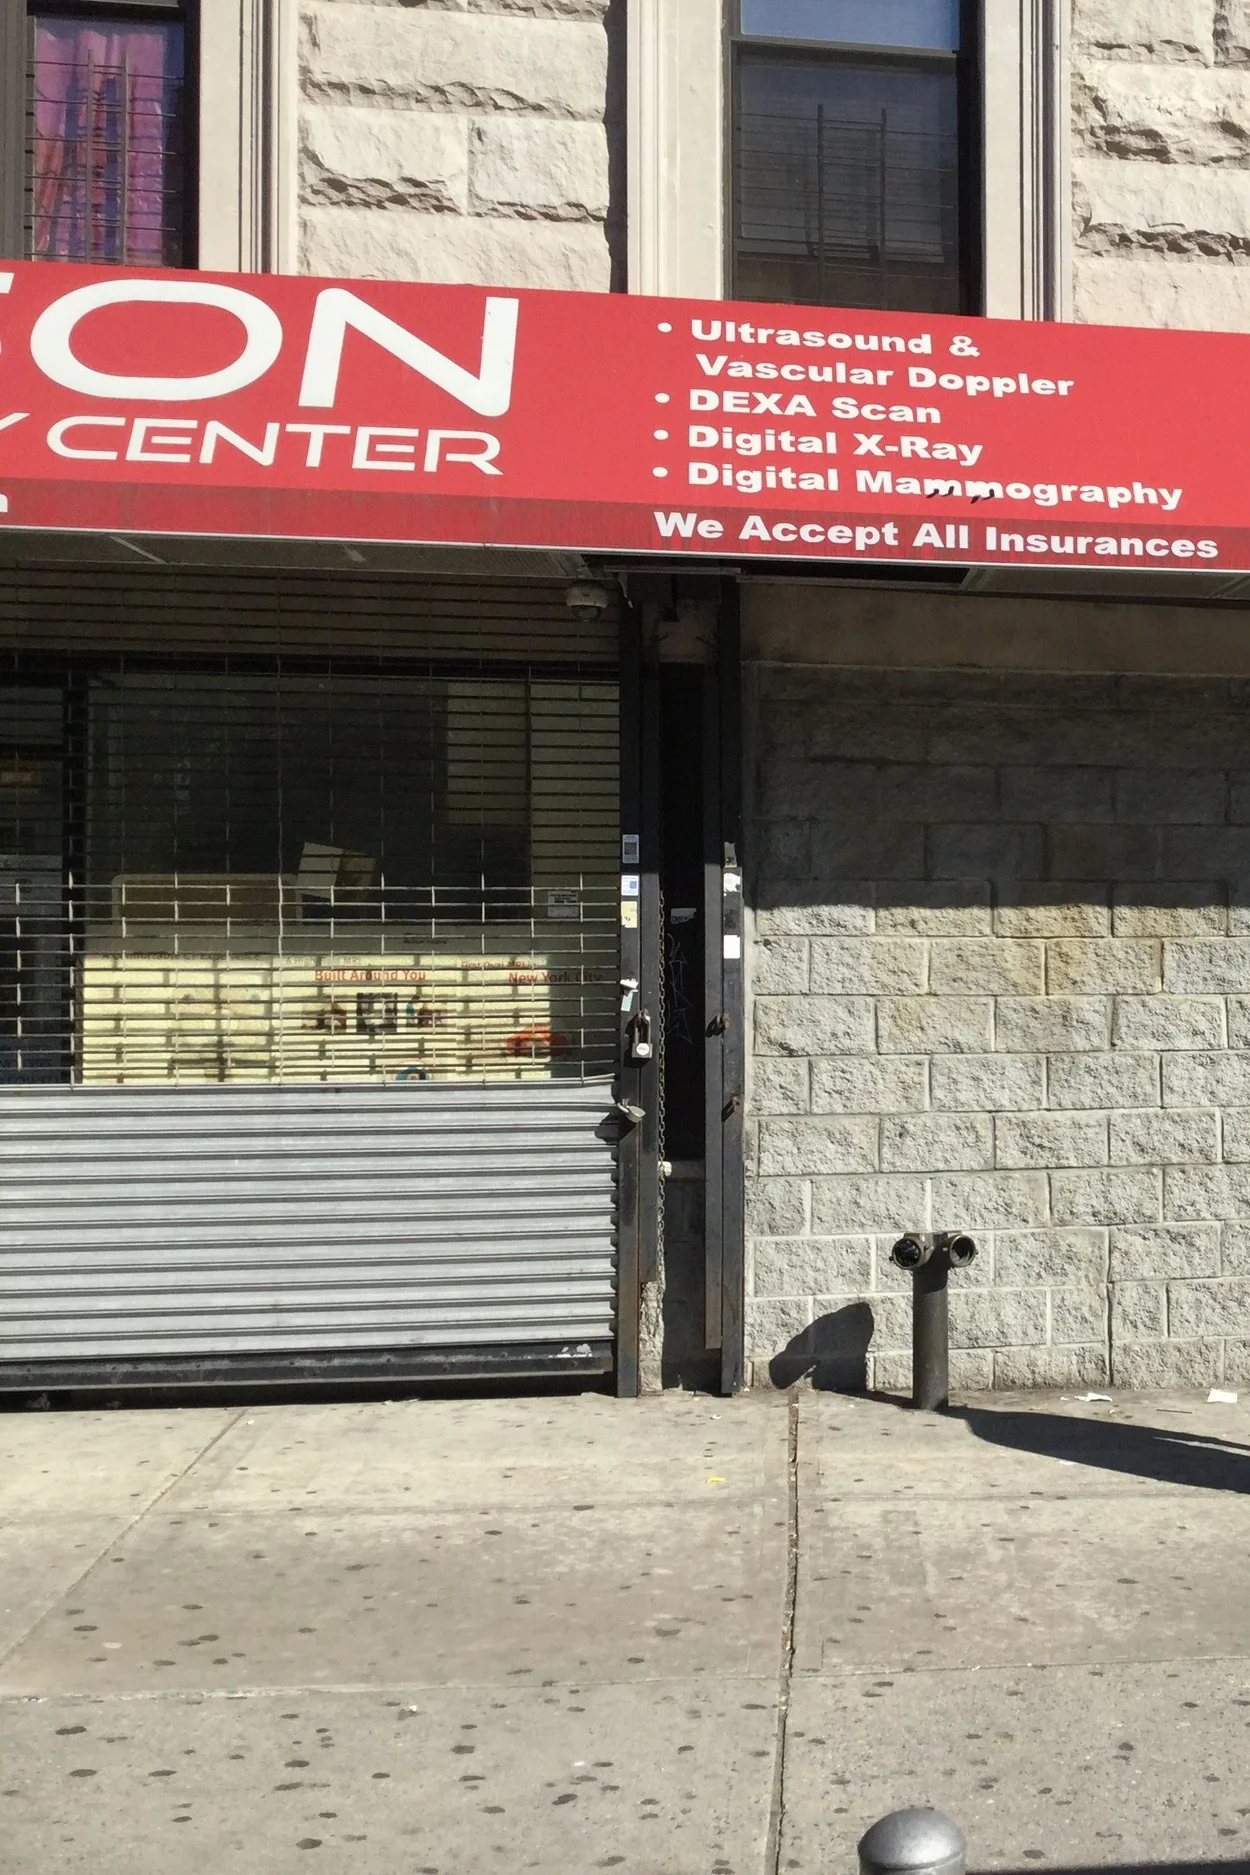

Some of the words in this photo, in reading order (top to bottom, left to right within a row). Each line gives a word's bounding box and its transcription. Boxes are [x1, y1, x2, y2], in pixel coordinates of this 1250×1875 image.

[0, 272, 519, 417] ON
[692, 320, 932, 354] Ultrasound
[949, 336, 980, 357] &
[696, 354, 894, 386] Vascular
[909, 367, 1074, 397] Doppler
[690, 389, 817, 416] DEXA
[832, 397, 940, 423] Scan
[47, 415, 503, 476] CENTER
[689, 425, 836, 456] Digital
[853, 434, 983, 466] X-Ray
[689, 462, 838, 493] Digital
[856, 470, 1182, 510] Mammography
[654, 512, 723, 539] We
[739, 516, 898, 550] Accept
[913, 523, 968, 549] All
[986, 527, 1218, 558] Insurances
[315, 969, 345, 981] Built
[403, 970, 426, 981] You
[509, 973, 538, 983] New
[542, 972, 571, 983] York
